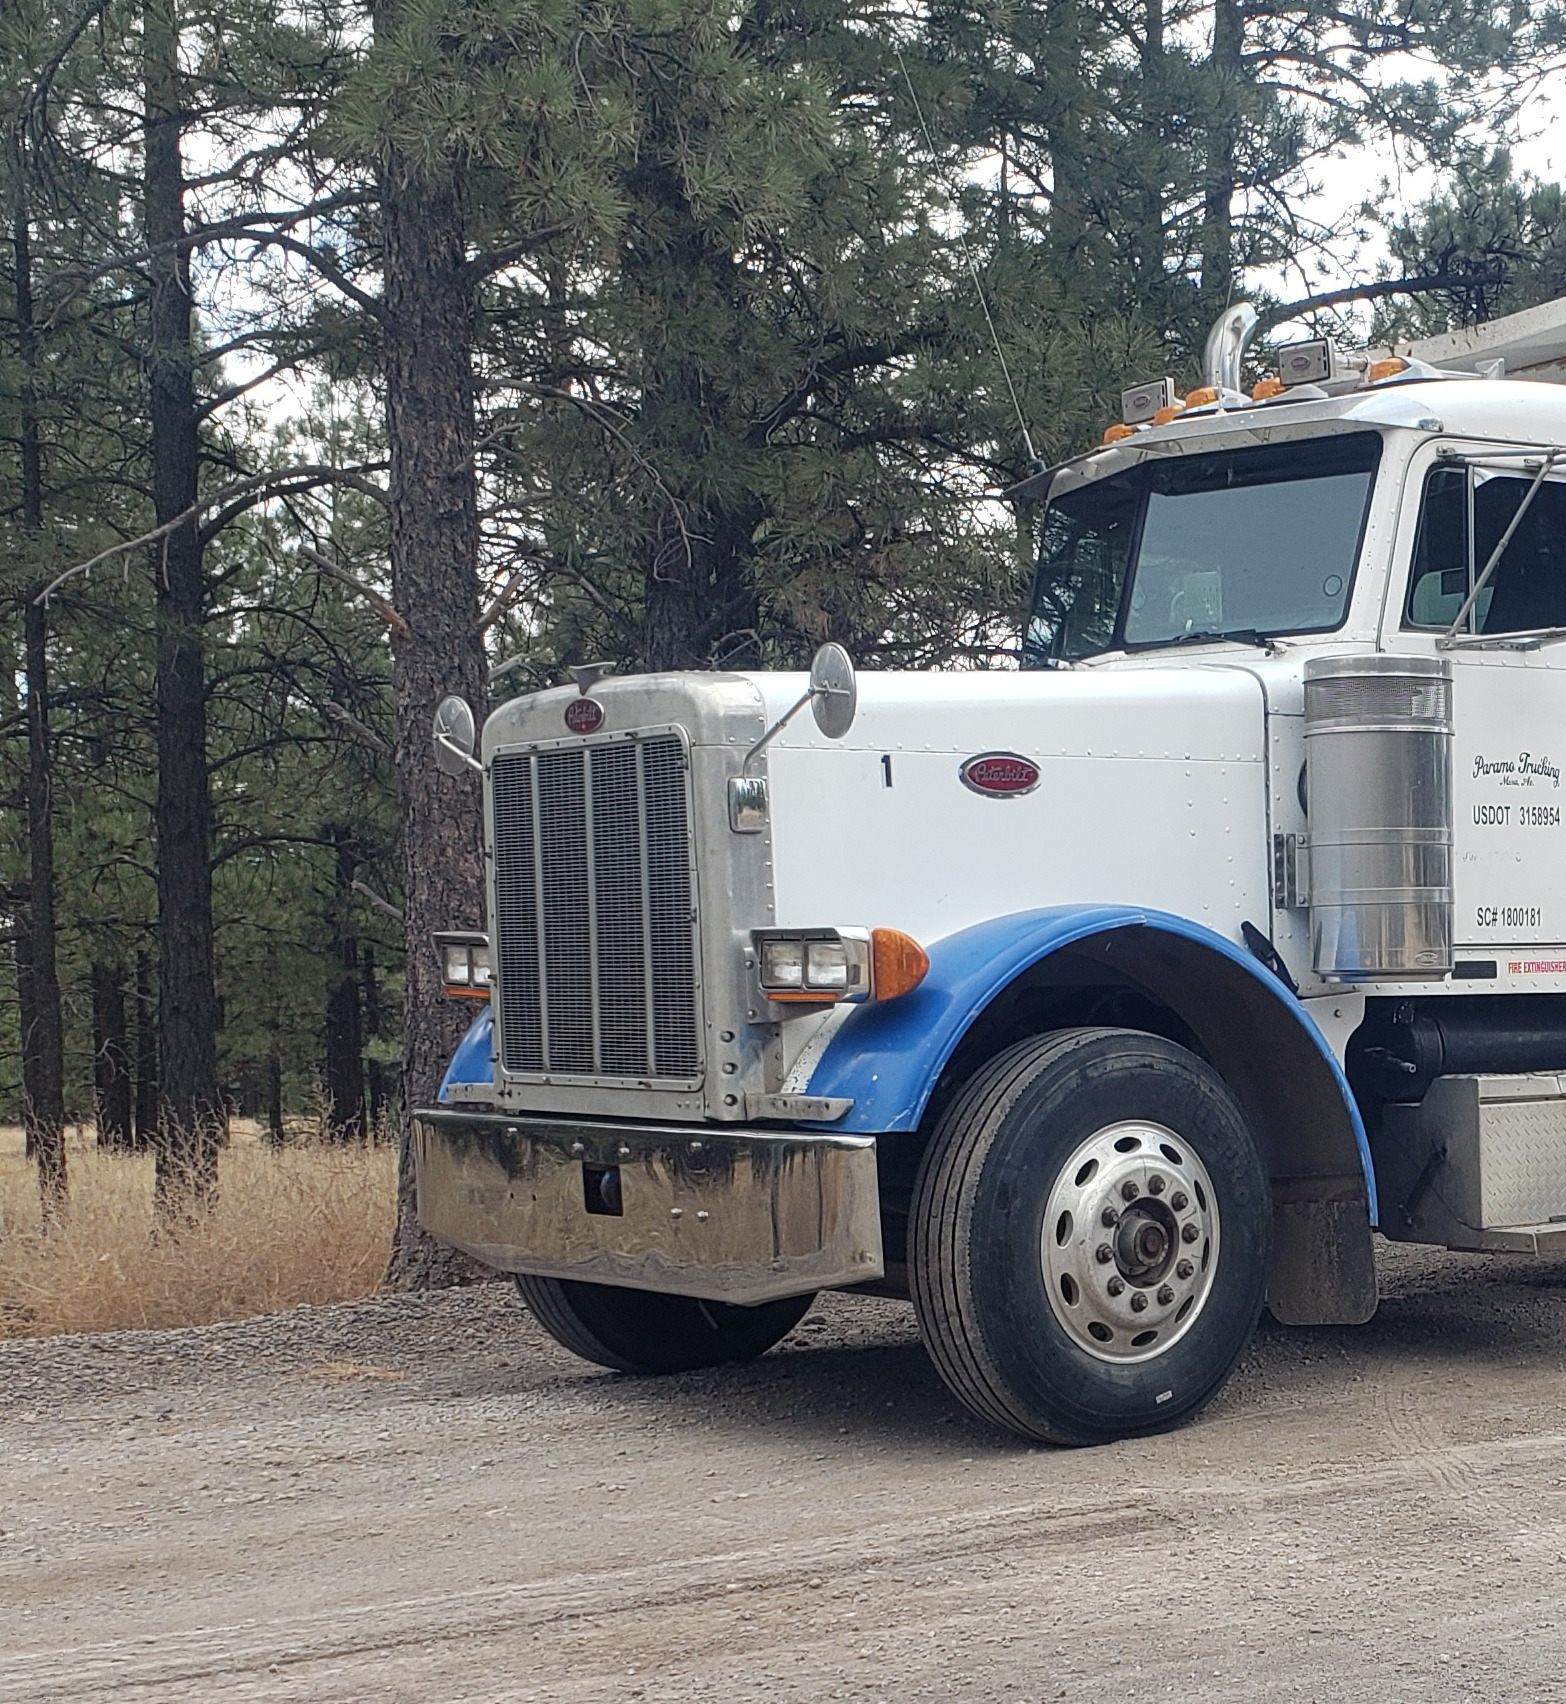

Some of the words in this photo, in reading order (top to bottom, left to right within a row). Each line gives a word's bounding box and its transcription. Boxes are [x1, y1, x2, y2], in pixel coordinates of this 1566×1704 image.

[881, 754, 892, 787] 1
[1472, 755, 1515, 778] Paramo
[1518, 752, 1560, 788] Trucking
[1473, 805, 1510, 825] USDOT
[1519, 806, 1560, 826] 3158954
[1476, 907, 1498, 927] SC#
[1501, 907, 1541, 926] 1800181
[1508, 962, 1522, 974] FIRE
[1523, 961, 1566, 973] EXTINGUISHER
